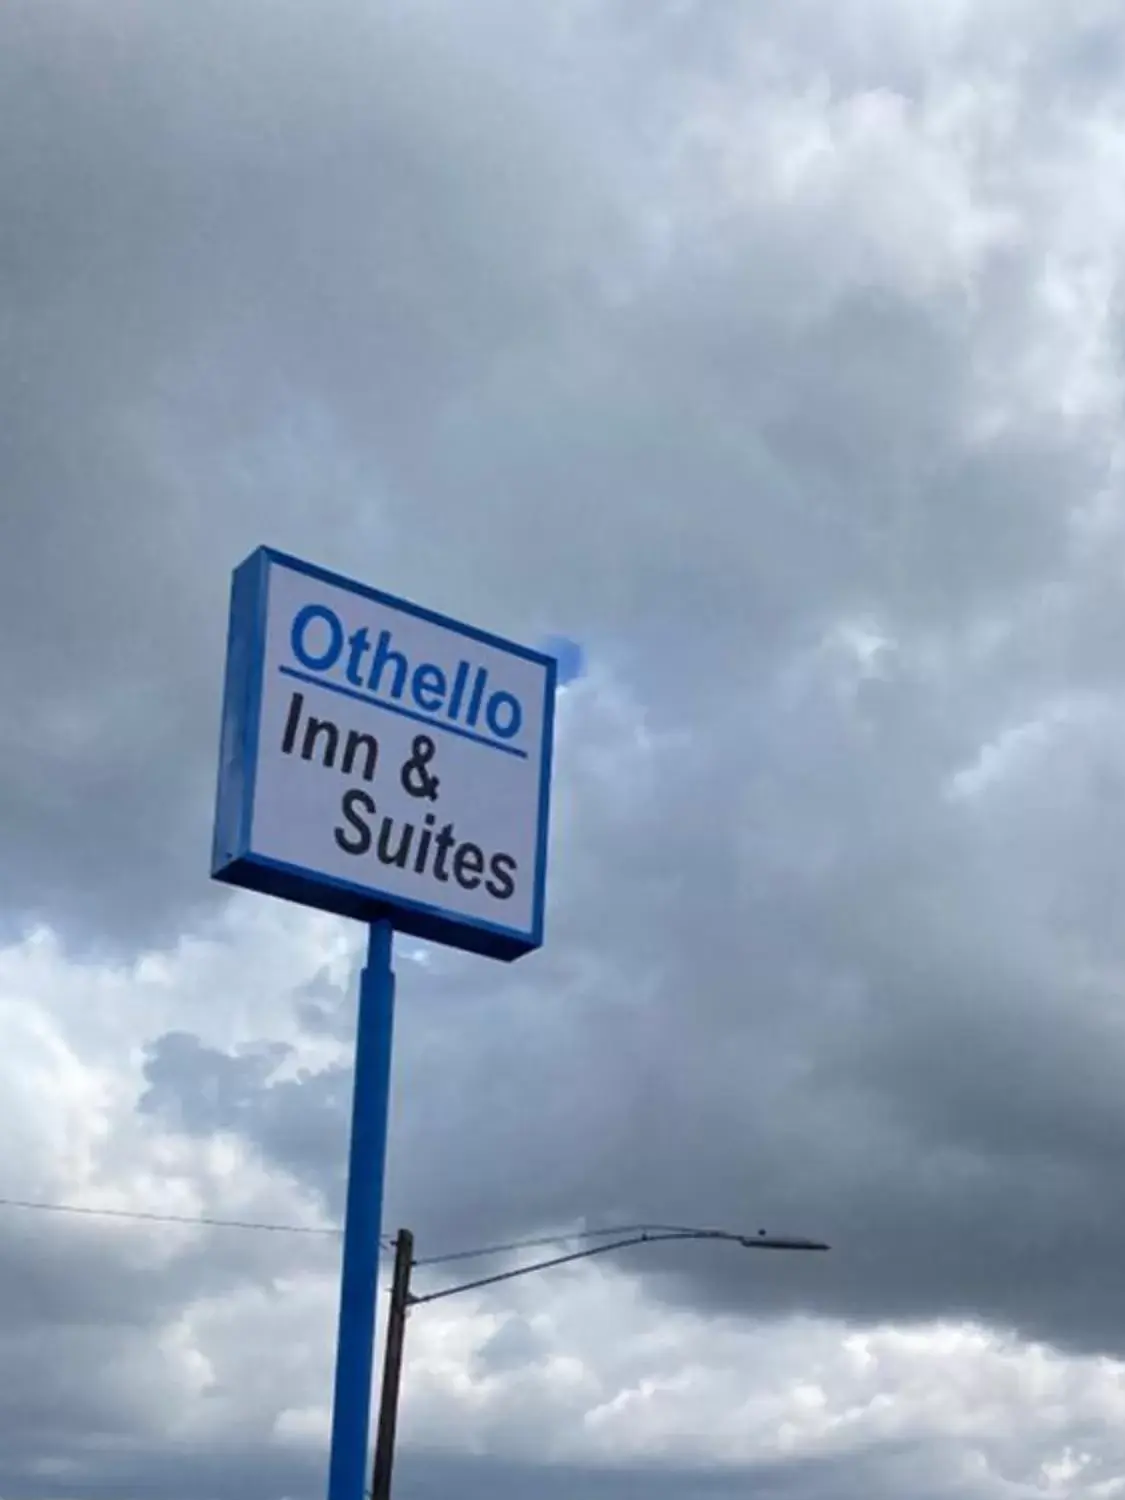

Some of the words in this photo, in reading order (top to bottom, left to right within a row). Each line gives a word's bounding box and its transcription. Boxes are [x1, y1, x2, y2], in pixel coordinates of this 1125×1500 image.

[291, 604, 522, 739] Othello
[281, 693, 379, 781] Inn
[401, 734, 439, 801] &
[334, 789, 517, 900] Suites
